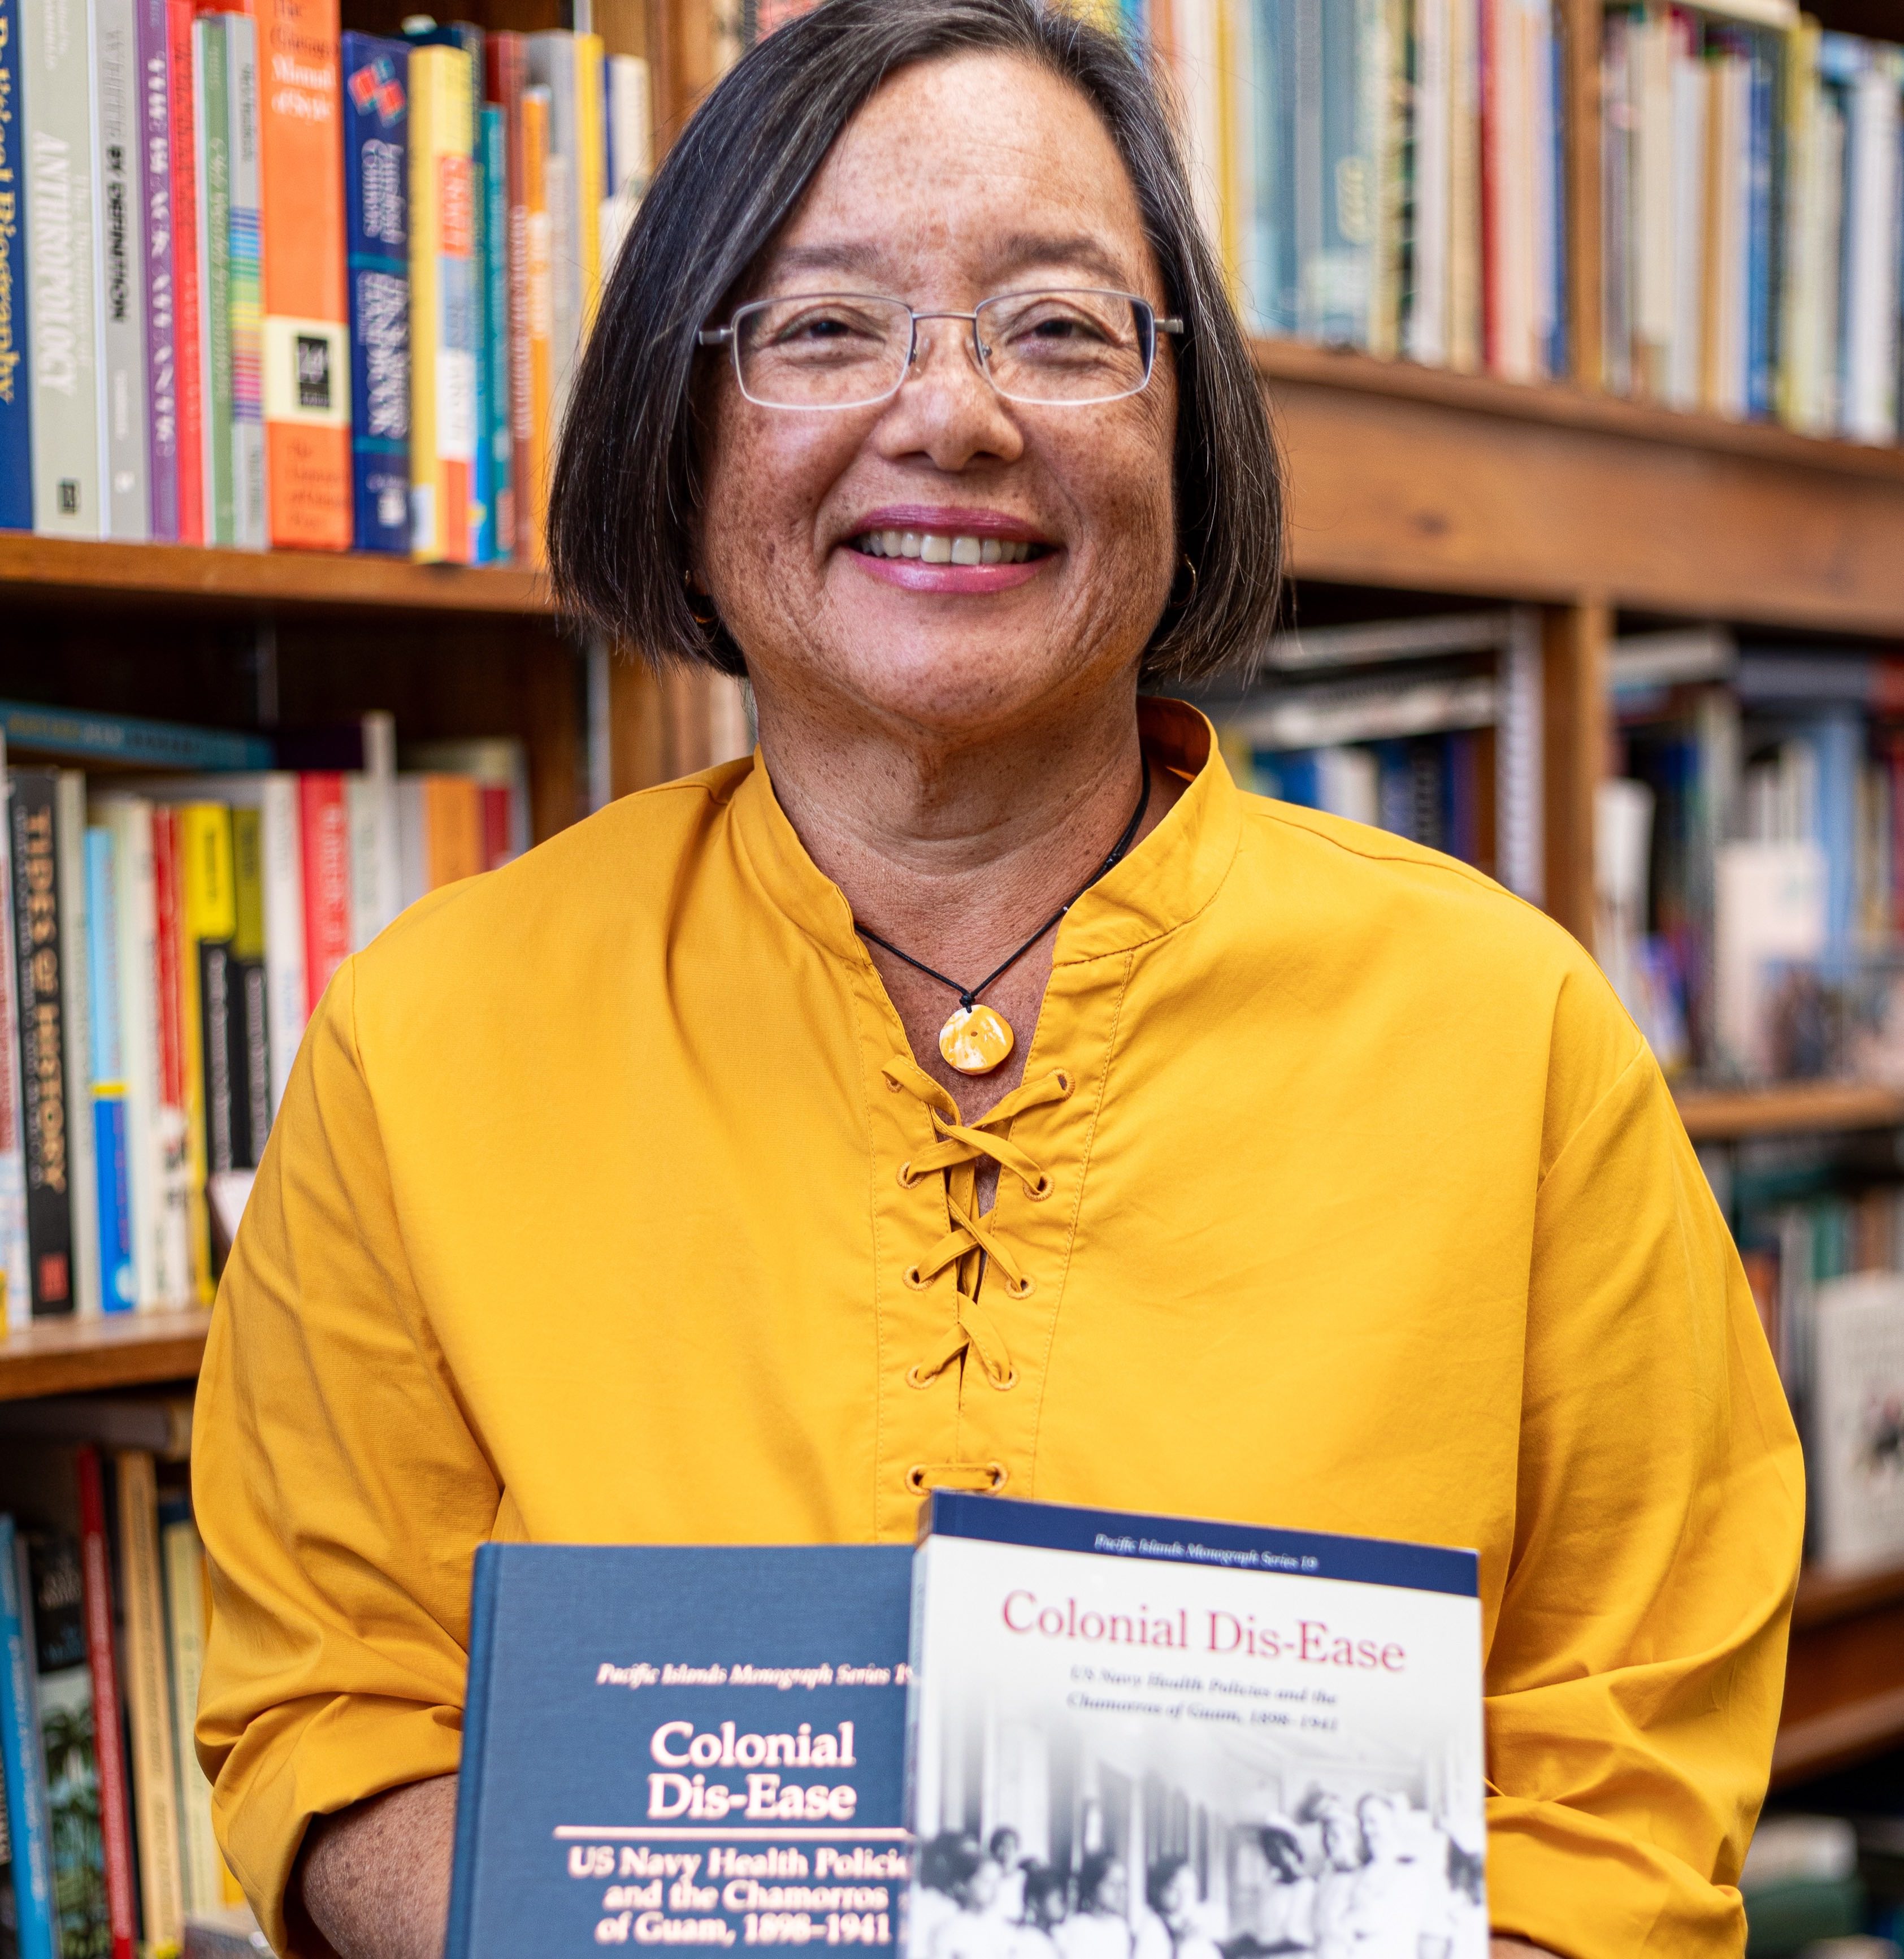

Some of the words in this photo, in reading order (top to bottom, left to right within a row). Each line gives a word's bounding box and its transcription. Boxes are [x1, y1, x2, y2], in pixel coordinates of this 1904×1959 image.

[272, 53, 336, 91] Manual
[107, 145, 124, 171] BY
[33, 131, 77, 395] ANTHROPOLOGY
[108, 180, 129, 322] DEFINITION
[26, 804, 56, 944] TIDES
[34, 1003, 66, 1193] HISTORY
[1095, 1533, 1137, 1556] Pacific
[1139, 1538, 1185, 1558] Islands
[1187, 1542, 1260, 1568] Monograph
[1261, 1550, 1299, 1570] Series
[1002, 1589, 1188, 1649] Colonial
[1207, 1608, 1406, 1672] Dis-Ease
[596, 1662, 660, 1690] Pacific
[661, 1663, 727, 1685] Islands
[728, 1662, 833, 1690] Monograph
[835, 1663, 890, 1685] Series
[1070, 1665, 1095, 1680] US
[1100, 1668, 1142, 1687] Navy
[1147, 1671, 1203, 1692] Health
[1209, 1677, 1271, 1697] Policies
[1275, 1686, 1307, 1703] and
[1312, 1687, 1337, 1705] the
[1066, 1691, 1163, 1714] Chamorros
[650, 1721, 857, 1767] Colonial
[648, 1773, 857, 1819] Dis-Ease
[569, 1845, 615, 1878] US
[620, 1846, 701, 1883] Navy
[708, 1847, 809, 1879] Health
[815, 1847, 908, 1879] Polici
[603, 1879, 663, 1911] and
[669, 1878, 719, 1912] the
[722, 1879, 890, 1912] Chamorros
[595, 1911, 632, 1944] of
[634, 1912, 736, 1947] Guam,
